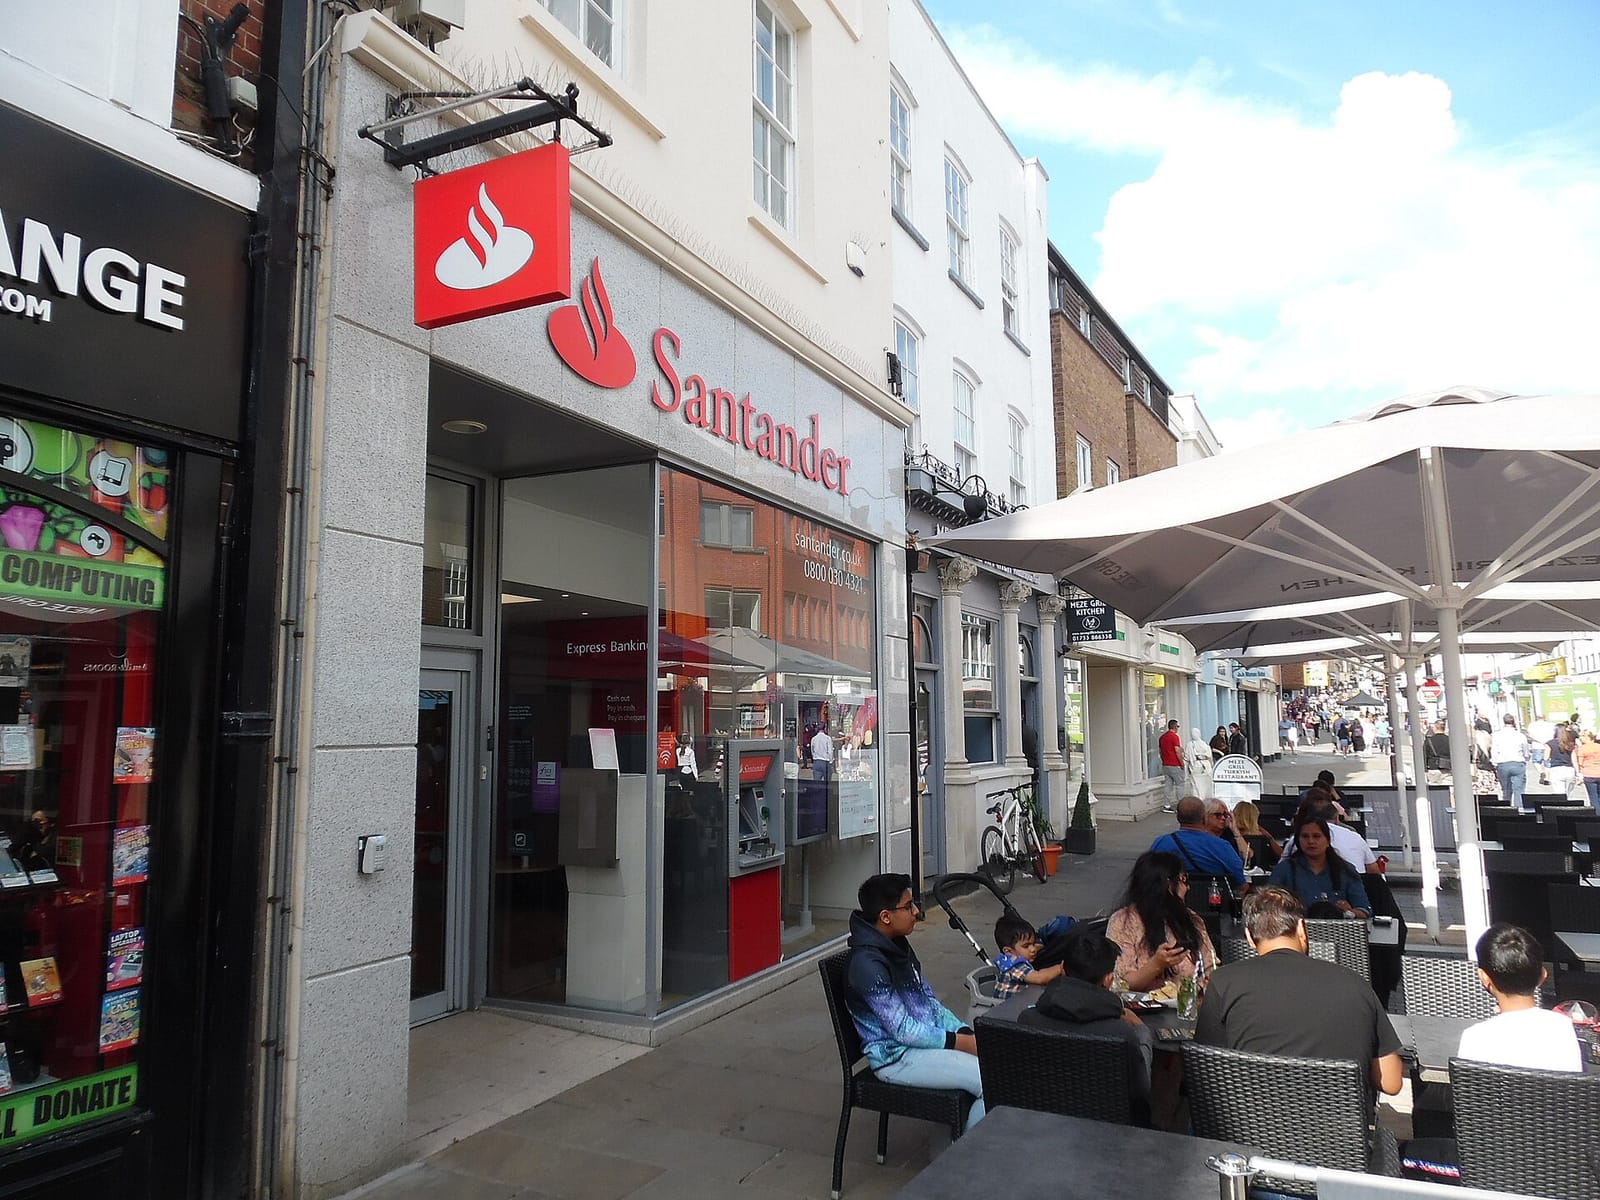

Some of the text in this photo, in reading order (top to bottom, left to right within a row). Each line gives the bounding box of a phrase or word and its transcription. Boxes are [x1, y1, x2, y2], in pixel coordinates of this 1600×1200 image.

[0, 285, 52, 322] OM
[651, 327, 851, 496] Santander
[795, 530, 862, 566] santander.co.uk
[2, 554, 156, 606] COMPUTING
[804, 559, 864, 593] 0800 030 4321
[1070, 599, 1107, 608] MEZE GRIL
[1076, 607, 1105, 616] KITCHEN
[566, 641, 607, 656] Express
[111, 929, 140, 943] LAPTOP
[33, 1075, 132, 1127] DONATE
